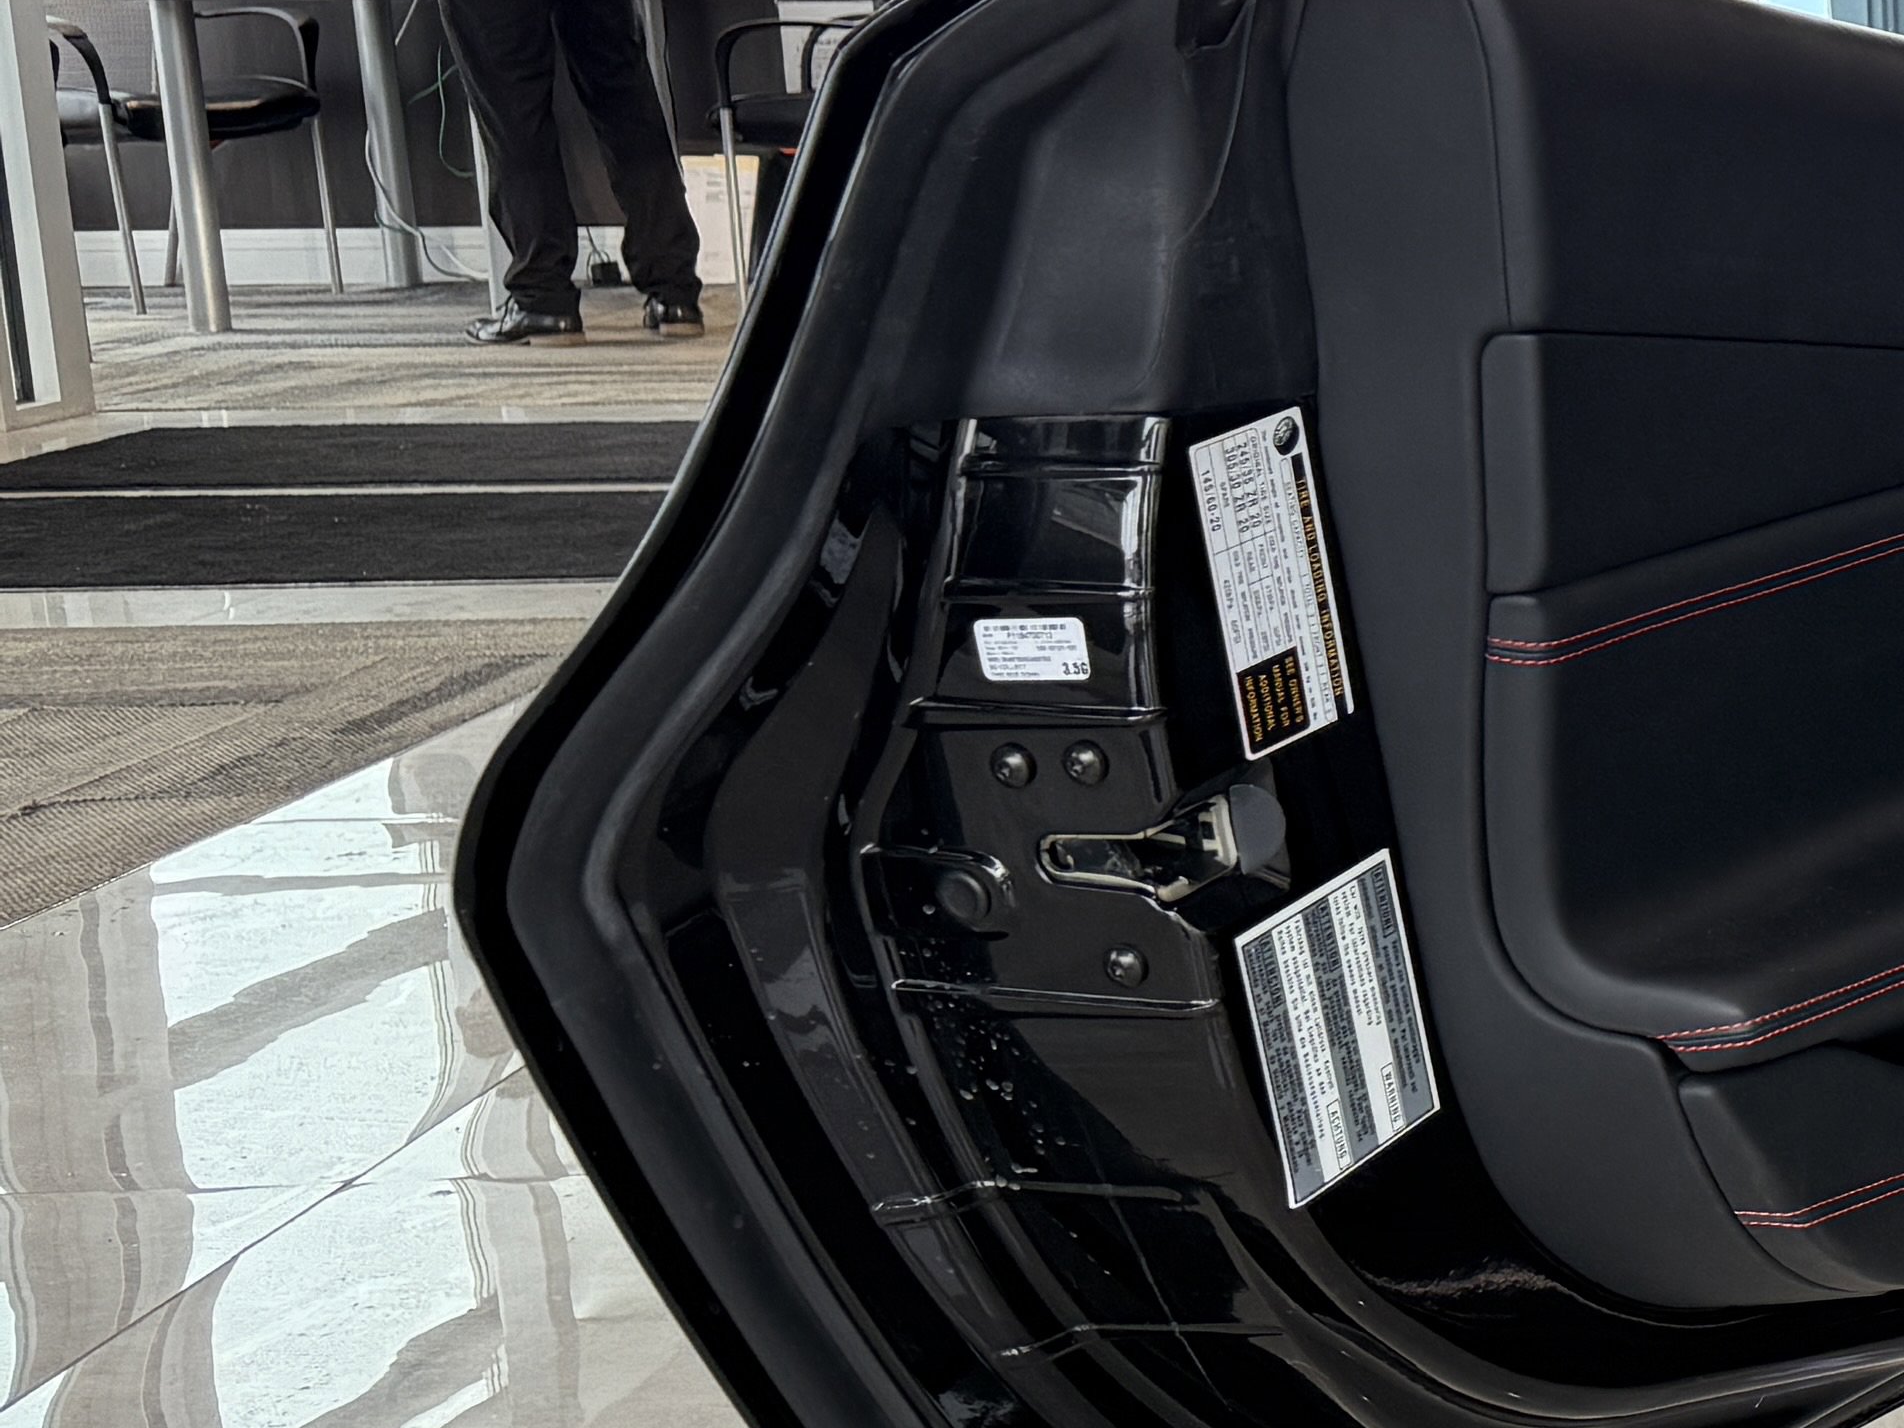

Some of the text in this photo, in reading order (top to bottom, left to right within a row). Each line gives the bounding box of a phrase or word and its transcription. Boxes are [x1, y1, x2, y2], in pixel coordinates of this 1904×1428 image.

[1318, 607, 1344, 697] INFORMATION
[1242, 673, 1265, 743] INFORMATION
[1256, 671, 1277, 732] ADDITIONAL
[1270, 662, 1287, 704] MANUAL
[1382, 1069, 1401, 1124] WARNING
[1329, 1107, 1348, 1161] ACHTUNG
